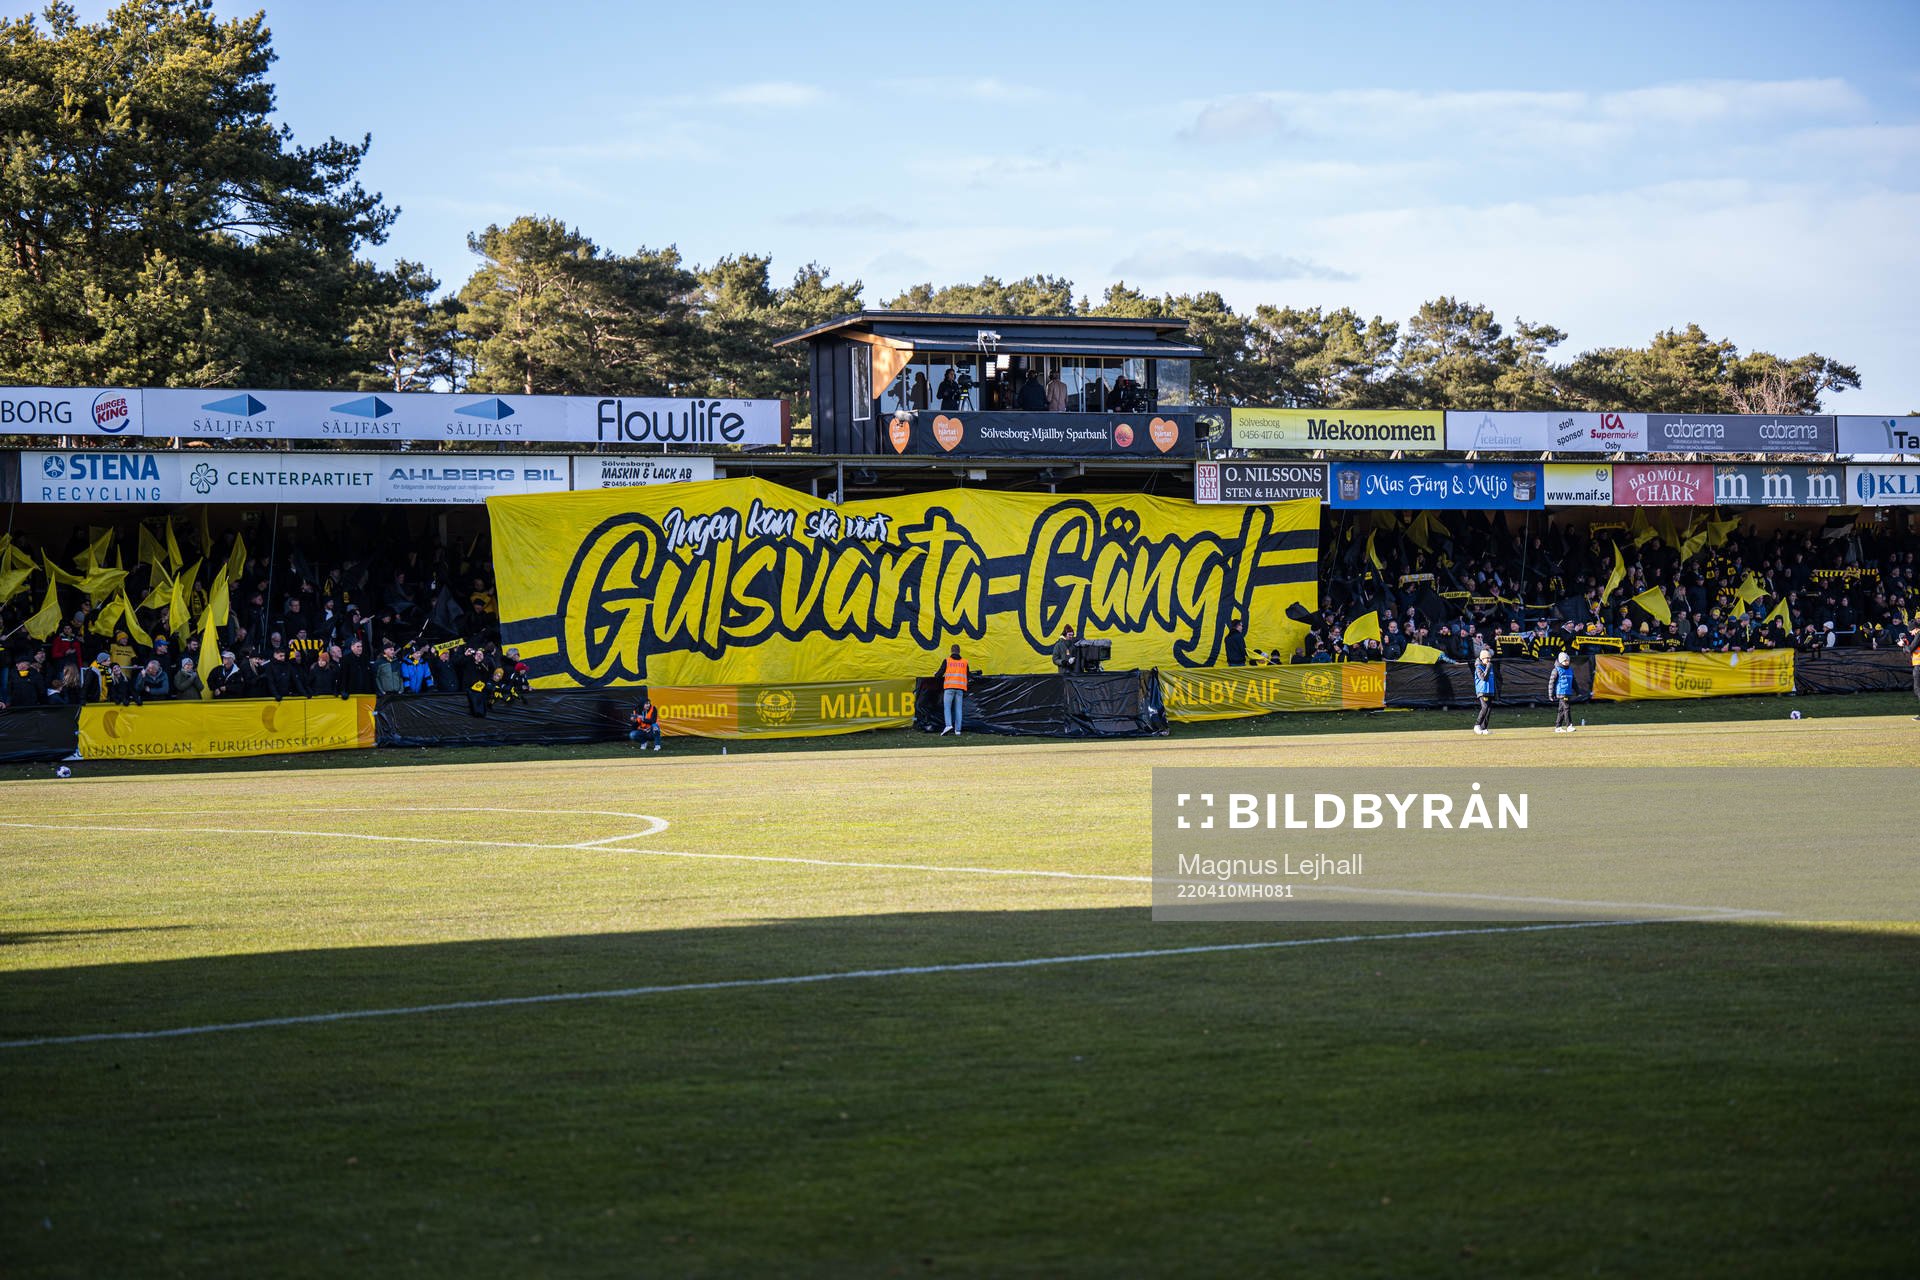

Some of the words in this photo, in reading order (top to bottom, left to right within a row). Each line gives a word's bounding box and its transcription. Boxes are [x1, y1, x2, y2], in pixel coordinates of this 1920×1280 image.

[1, 400, 72, 424] BORG
[95, 398, 126, 414] BURGER
[97, 405, 128, 425] KING
[1600, 413, 1625, 430] ICA
[193, 419, 276, 434] SÄLJFAST
[322, 420, 401, 436] SÄLJFAST
[446, 422, 523, 437] SÄLJFAST
[1307, 418, 1436, 442] Mekonomen
[1558, 418, 1574, 431] stolt
[1664, 418, 1725, 439] colorama
[1759, 419, 1818, 440] colorama
[980, 426, 1065, 442] Sölvesborg-Mjällby
[1066, 427, 1108, 442] Sparbank
[1481, 433, 1522, 445] icetainer
[1557, 429, 1584, 447] sponsor
[1590, 429, 1639, 440] Supermarket
[1893, 431, 1920, 449] Ta
[1605, 442, 1621, 451] Osby
[69, 454, 160, 480] STENA
[601, 460, 656, 468] Sölvesborgs
[1200, 466, 1217, 477] SYD
[228, 471, 374, 486] CENTERPARTIET
[388, 468, 515, 482] AHLBERG
[524, 469, 563, 481] BIL
[601, 467, 640, 479] MASKIN
[643, 468, 650, 479] &
[653, 468, 677, 480] LACK
[679, 468, 693, 479] AB
[1225, 467, 1241, 482] O.
[1245, 467, 1322, 482] NILSSONS
[1629, 467, 1700, 491] BROMÖLLA
[42, 486, 161, 501] RECYCLING
[1225, 487, 1252, 498] STEN
[1255, 487, 1263, 498] &
[1265, 487, 1322, 498] HANTVERK
[1366, 474, 1404, 495] Mias
[1408, 475, 1448, 499] Färg
[1452, 475, 1465, 495] &
[1468, 474, 1508, 499] Miljö
[1635, 484, 1695, 503] CHARK
[1547, 489, 1611, 501] www.maif.se
[664, 508, 738, 556] Ingen
[748, 501, 795, 537] kan
[1021, 502, 1271, 664] Gäng!
[1244, 678, 1281, 704] AIF
[1674, 674, 1713, 692] Group
[820, 687, 916, 719] MJÄLLB
